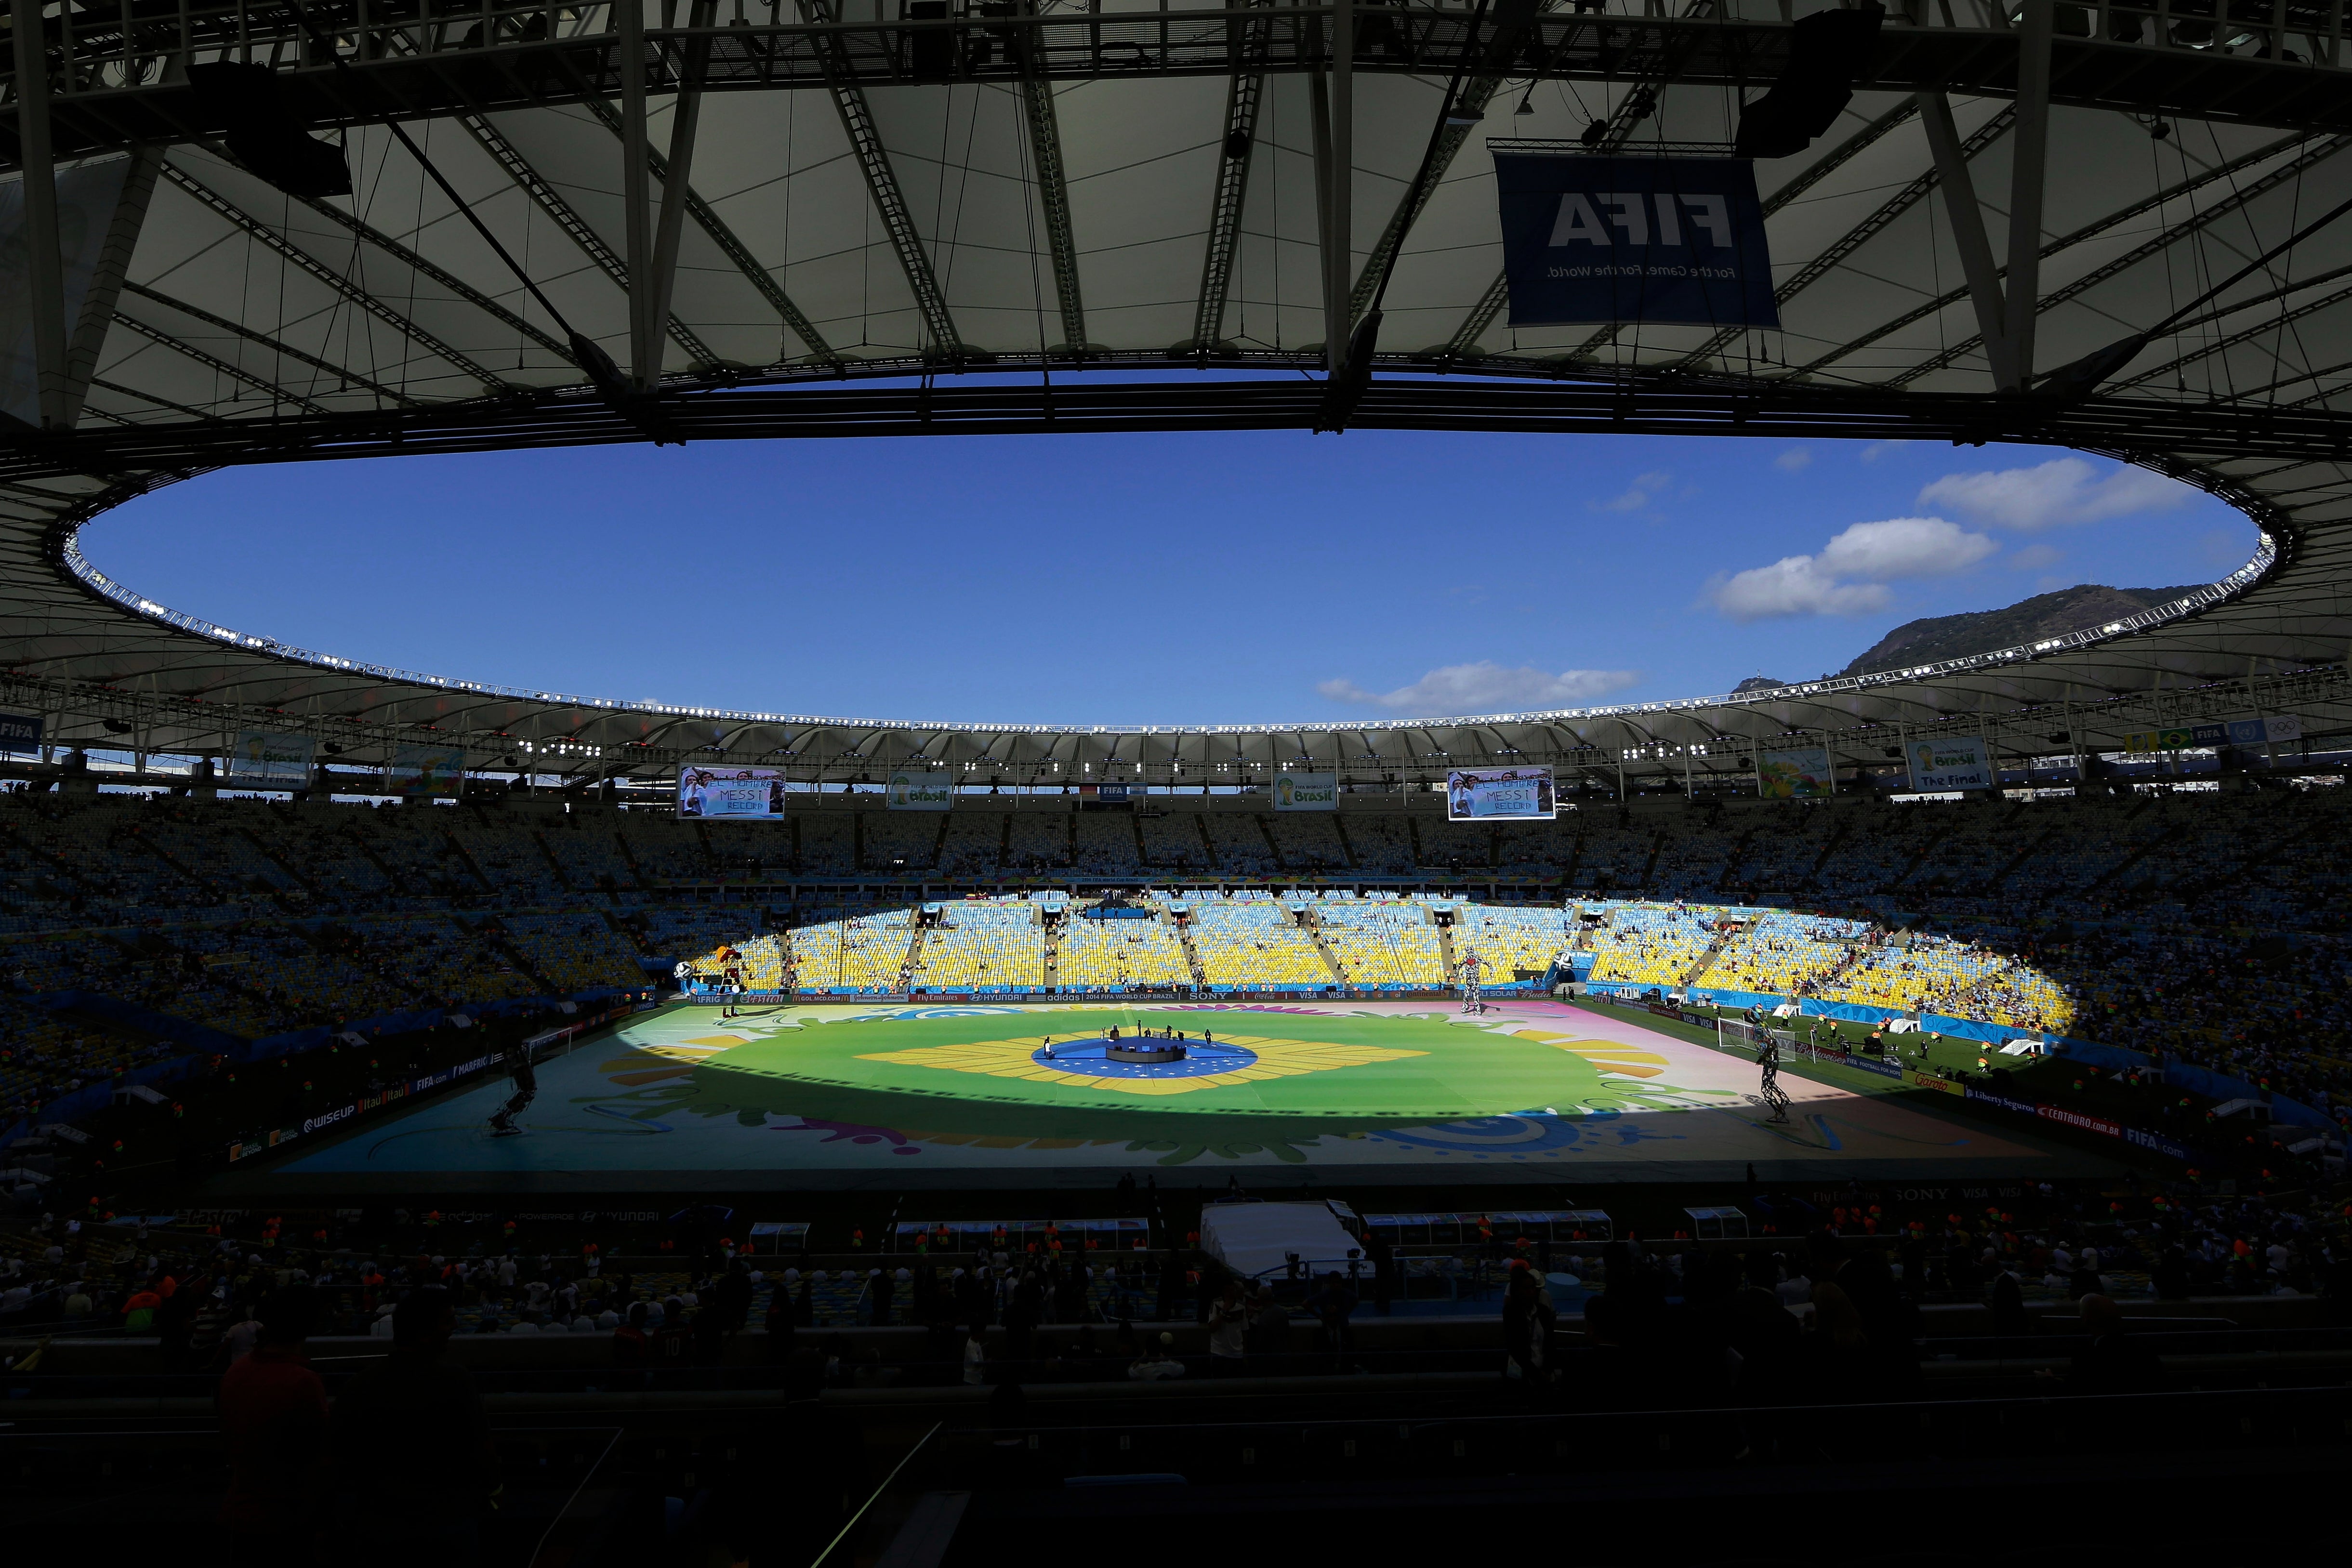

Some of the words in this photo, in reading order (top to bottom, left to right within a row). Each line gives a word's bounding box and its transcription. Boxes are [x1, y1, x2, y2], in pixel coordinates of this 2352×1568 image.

[0, 723, 33, 738] FIFA
[2196, 729, 2220, 739] FIFA
[1935, 753, 1976, 766] Brasil
[1921, 776, 1945, 786] The
[1948, 773, 1982, 786] Final
[910, 790, 947, 802] Brasil
[1295, 790, 1333, 802] Brasil
[728, 802, 763, 810] RECORD
[1682, 1013, 1696, 1025] VISA
[1699, 1017, 1713, 1029] VISA
[1847, 1057, 1857, 1066] FIFA
[1915, 1073, 1949, 1091] Garoto
[1975, 1090, 2001, 1107] Liberty
[2004, 1098, 2035, 1113] Seguros
[1813, 1191, 1831, 1203] Fly
[1896, 1187, 1951, 1201] SONY
[1962, 1187, 1989, 1199] VISA
[664, 1337, 680, 1357] 10
